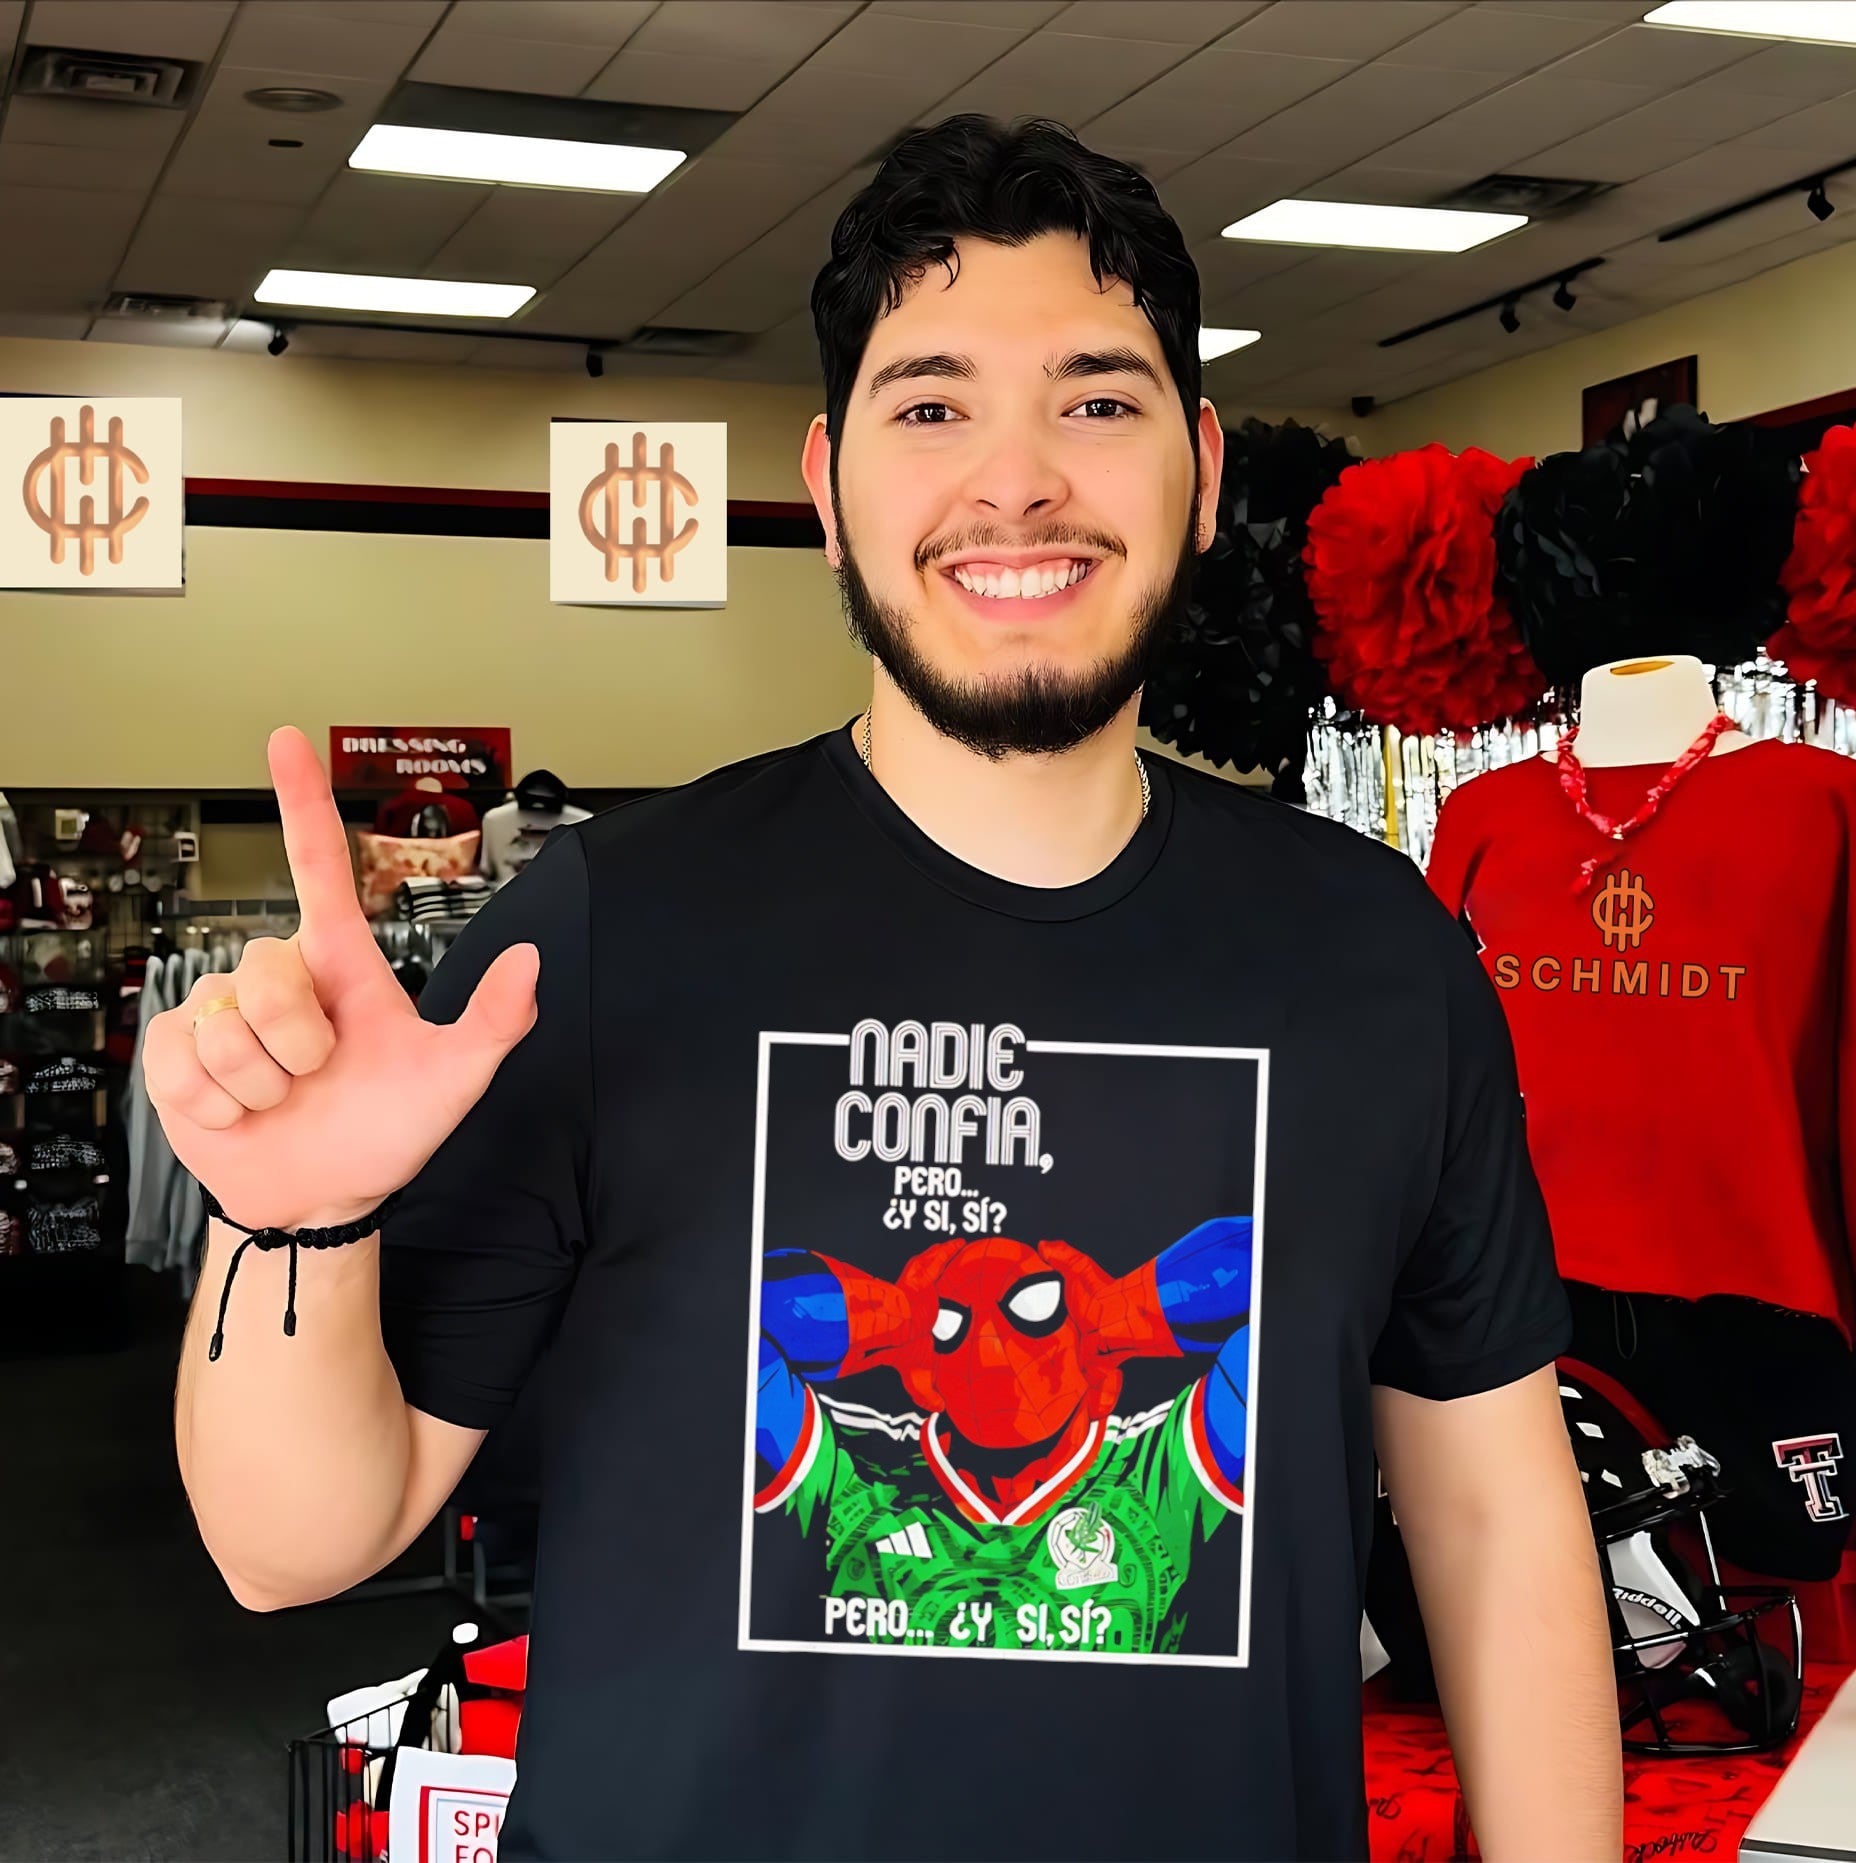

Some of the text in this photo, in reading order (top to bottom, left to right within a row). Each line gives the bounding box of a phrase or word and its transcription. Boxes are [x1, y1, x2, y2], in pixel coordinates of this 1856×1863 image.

[342, 737, 467, 753] DRESSING
[396, 758, 487, 774] ROOMS
[1494, 954, 1746, 999] SCHMIDT
[850, 1018, 1026, 1091] NADIE
[835, 1090, 1054, 1174] CONFIA,
[894, 1166, 979, 1197] PERO...
[883, 1197, 1007, 1235] ¿Y SI, SÍ?
[825, 1597, 935, 1638] PERO...
[950, 1602, 992, 1641] ¿Y
